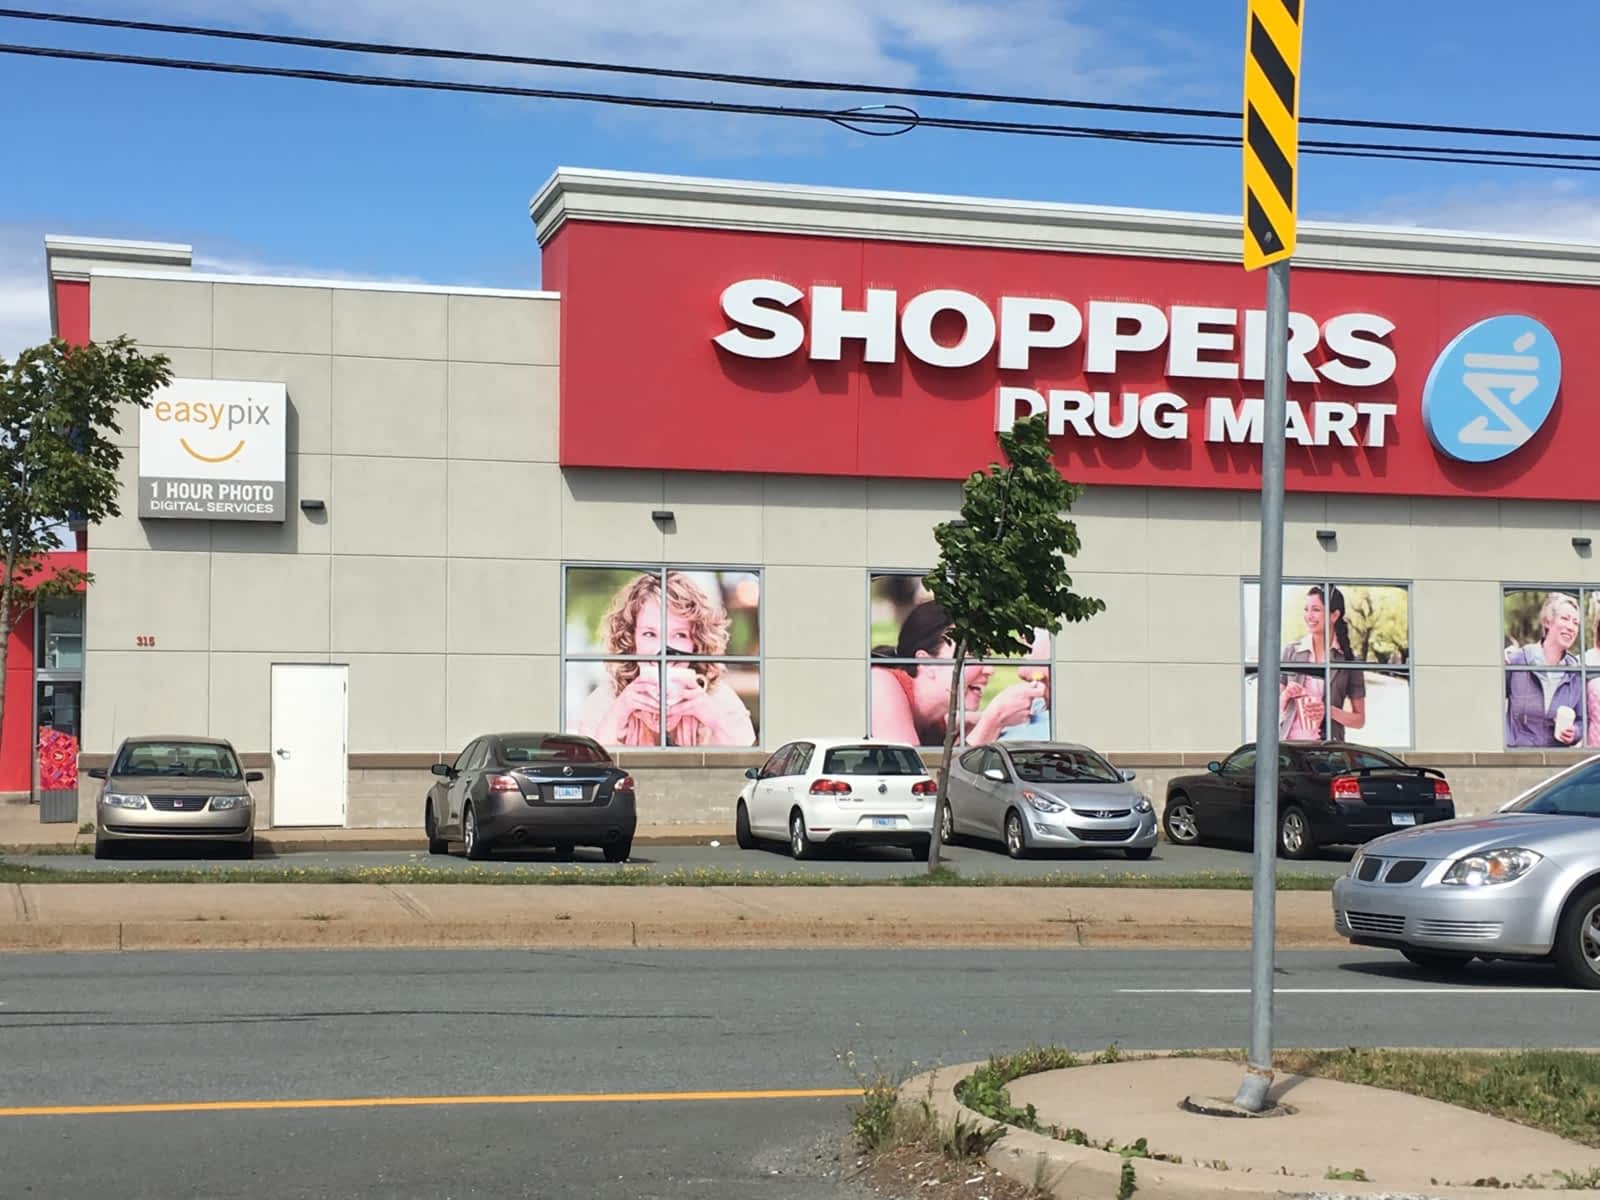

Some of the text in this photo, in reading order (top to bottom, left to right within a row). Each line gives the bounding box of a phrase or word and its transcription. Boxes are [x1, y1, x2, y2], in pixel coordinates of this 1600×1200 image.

[712, 278, 1397, 386] SHOPPERS
[155, 397, 270, 430] easypix
[994, 386, 1188, 440] DRUG
[151, 481, 274, 501] 1 HOUR PHOTO
[151, 500, 274, 513] DIGITAL SERVICES
